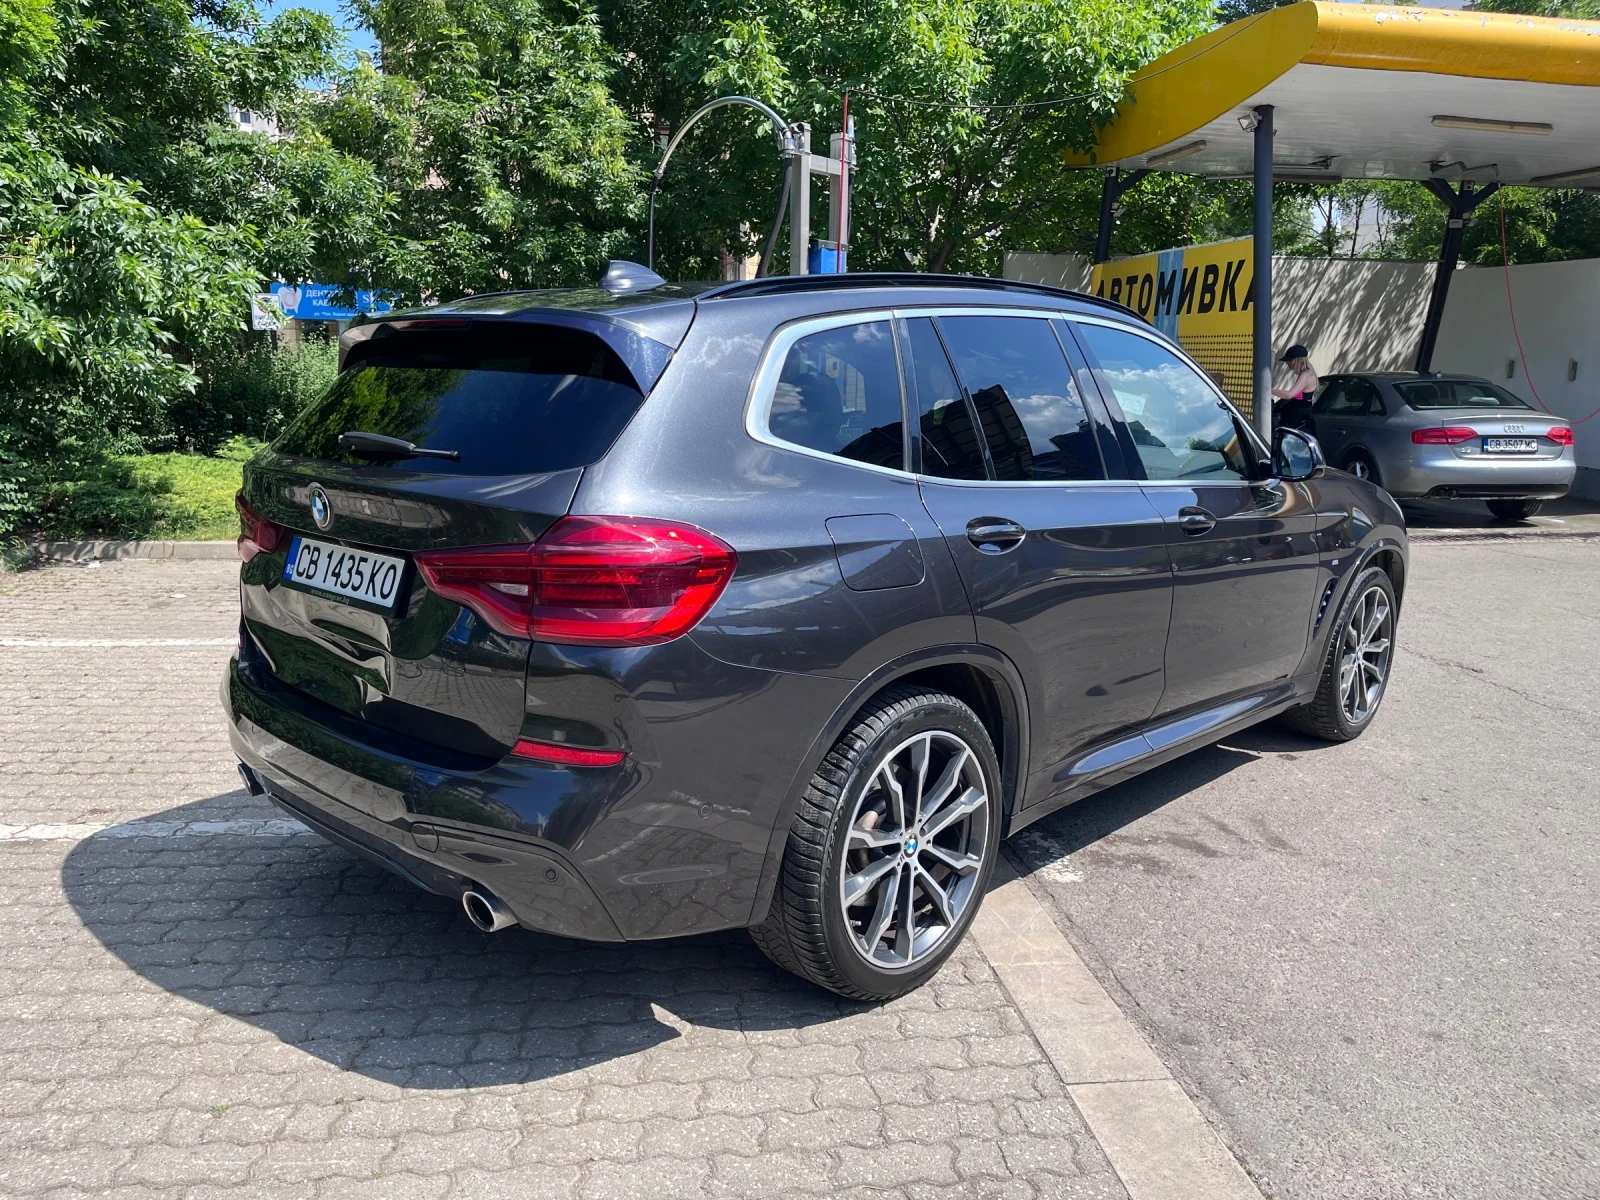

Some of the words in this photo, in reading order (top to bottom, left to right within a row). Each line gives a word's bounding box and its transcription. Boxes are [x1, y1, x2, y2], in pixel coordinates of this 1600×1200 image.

[305, 290, 344, 298] ДЕНТ
[1502, 440, 1524, 449] 3507
[296, 544, 321, 580] CB
[322, 549, 369, 592] 1435
